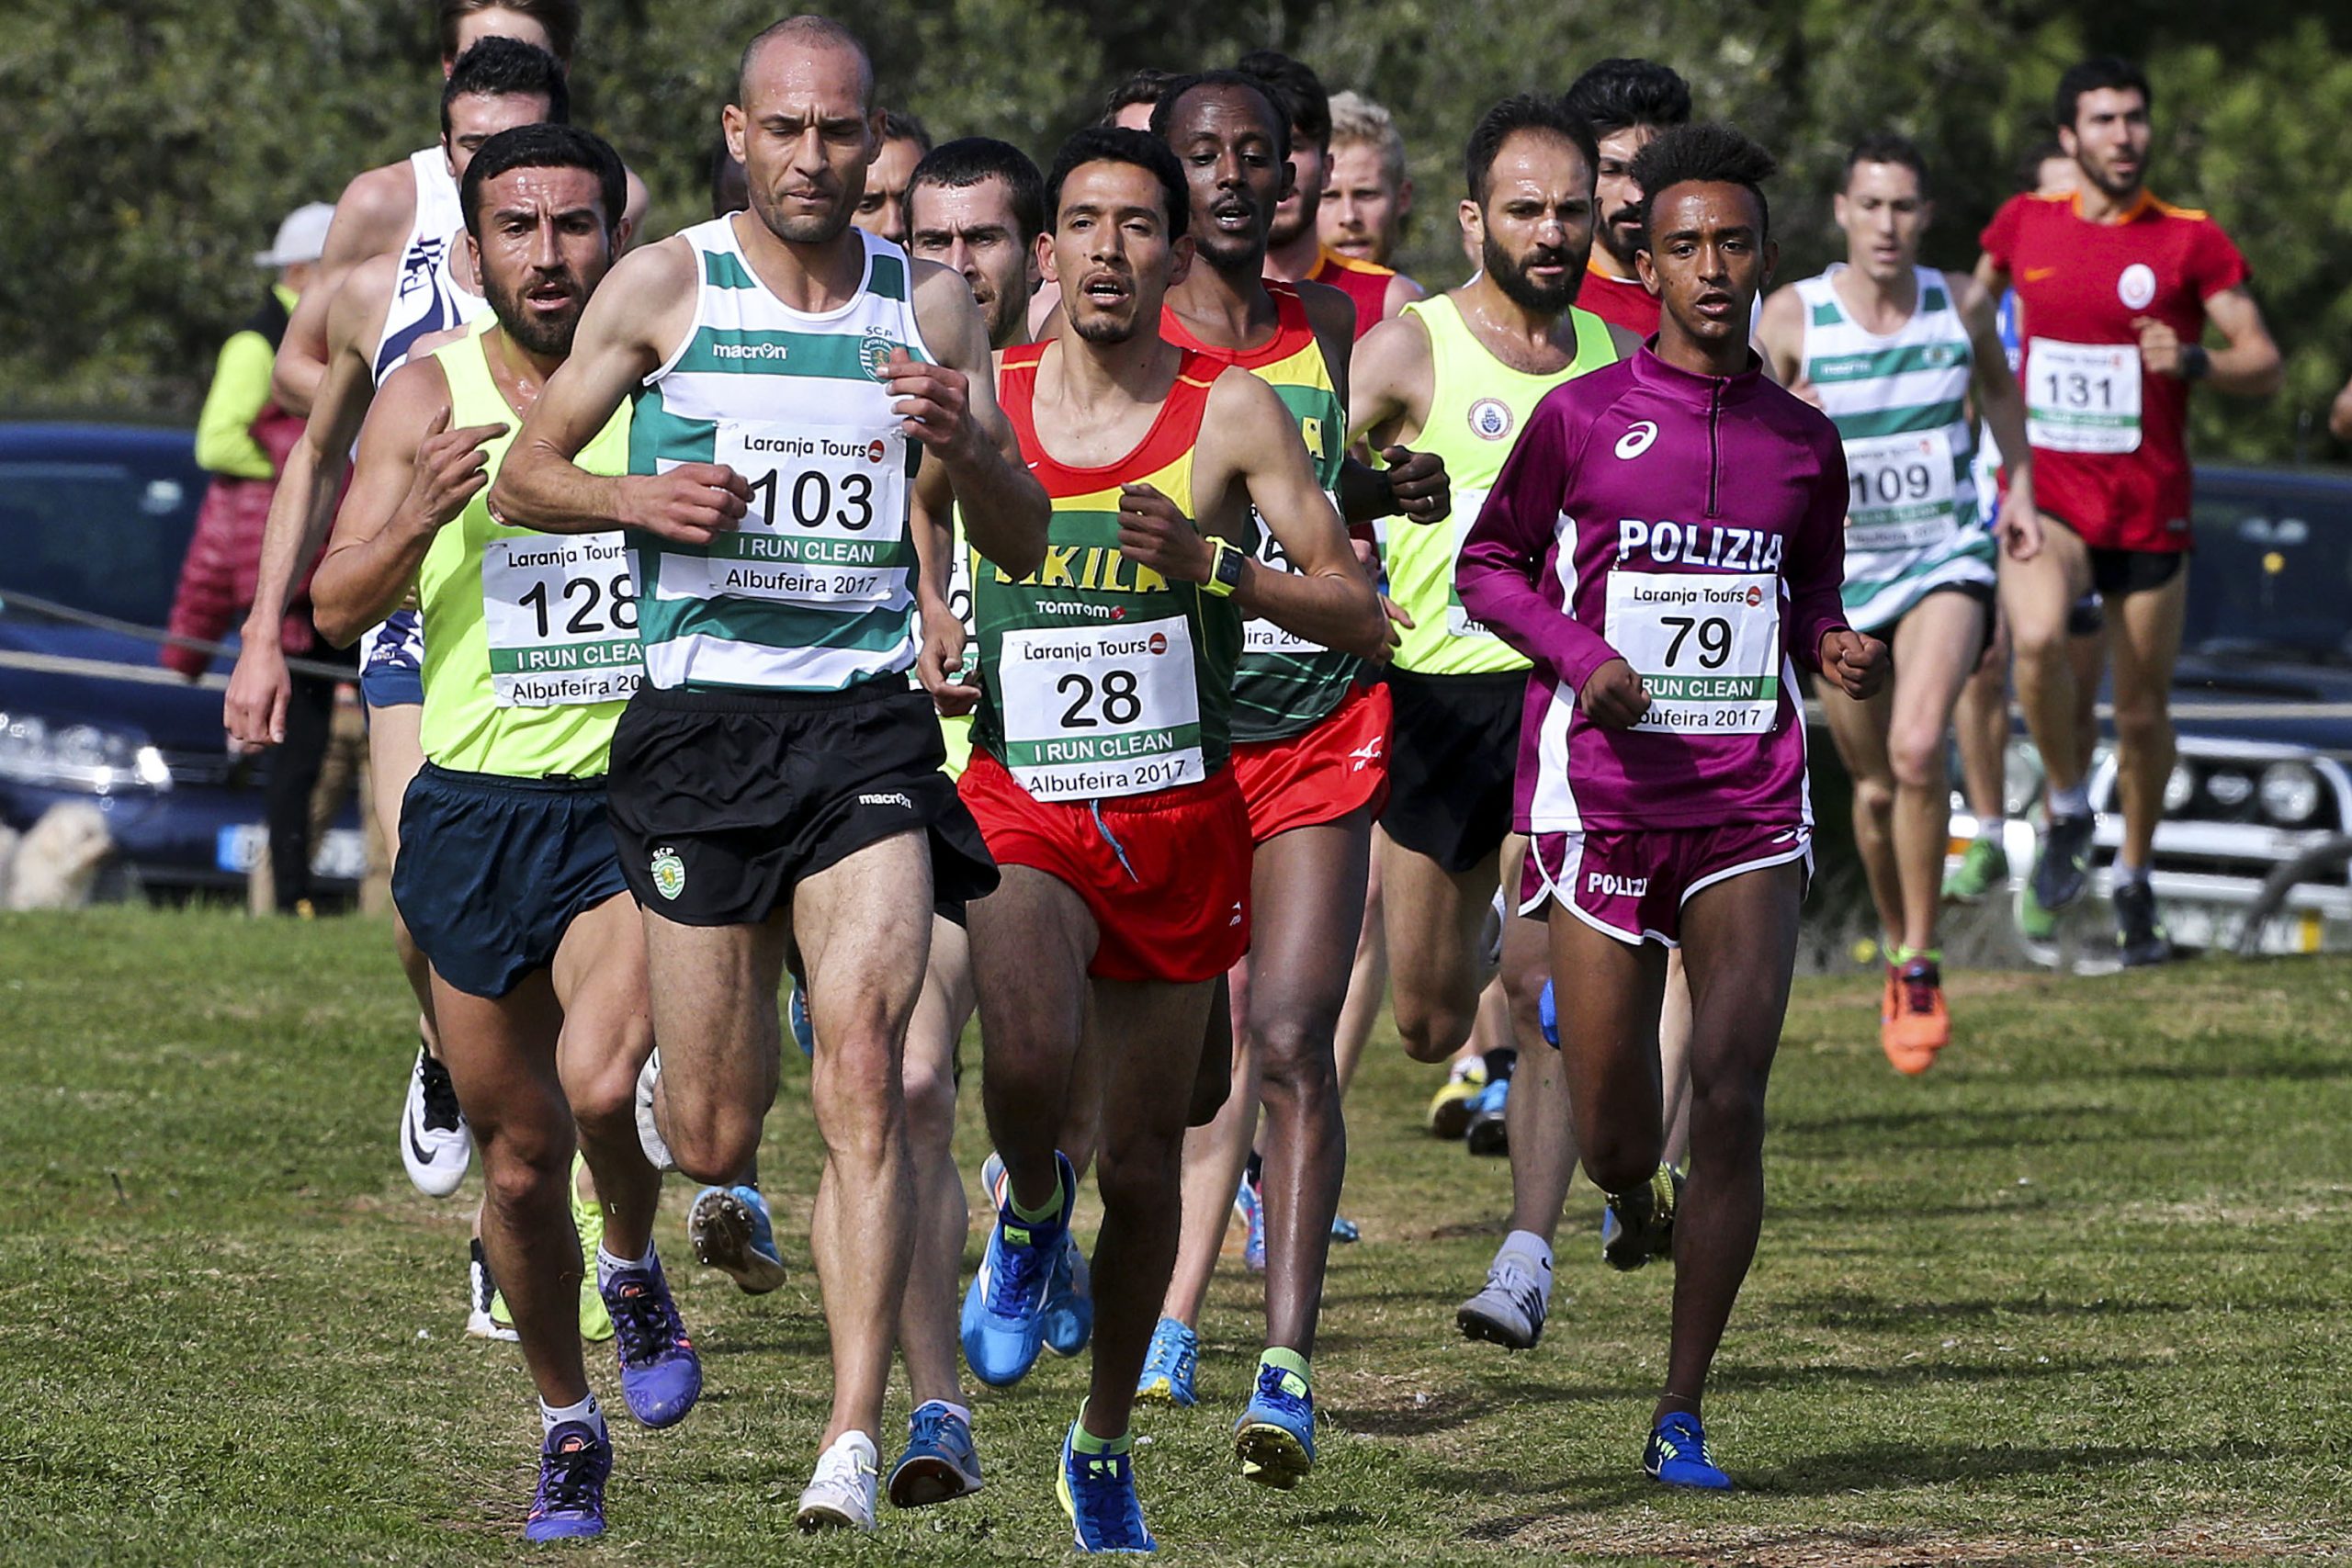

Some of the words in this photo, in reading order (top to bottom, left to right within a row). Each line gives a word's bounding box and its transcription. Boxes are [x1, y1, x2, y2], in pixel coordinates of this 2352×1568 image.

[713, 343, 787, 359] macron
[2045, 373, 2111, 412] 131
[744, 434, 814, 457] Laranja
[820, 439, 866, 457] Tours
[1850, 463, 1929, 504] 109
[749, 468, 873, 531] 103
[508, 547, 577, 568] Laranja
[739, 537, 744, 555] I
[752, 539, 798, 558] RUN
[804, 542, 875, 563] CLEAN
[1618, 519, 1783, 572] POLIZIA
[726, 569, 827, 592] Albufeira
[833, 575, 878, 593] 2017
[518, 573, 639, 637] 128
[1634, 587, 1697, 606] Laranja
[1703, 589, 1744, 603] Tours
[1024, 641, 1091, 662] Laranja
[1098, 639, 1147, 656] Tours
[1661, 616, 1732, 669] 79
[517, 651, 523, 669] I
[529, 649, 577, 668] RUN
[582, 643, 643, 664] CLEA
[514, 680, 610, 700] Albufeira
[616, 673, 641, 692] 20
[1057, 670, 1141, 728] 28
[1642, 678, 1683, 696] RUN
[1689, 680, 1753, 697] CLEAN
[1714, 710, 1760, 727] 2017
[1035, 745, 1041, 762] I
[1047, 740, 1094, 761] RUN
[1100, 732, 1173, 757] CLEAN
[1028, 772, 1129, 794] Albufeira
[1135, 760, 1186, 785] 2017
[652, 847, 674, 860] SCP
[1588, 872, 1648, 897] POLIZI
